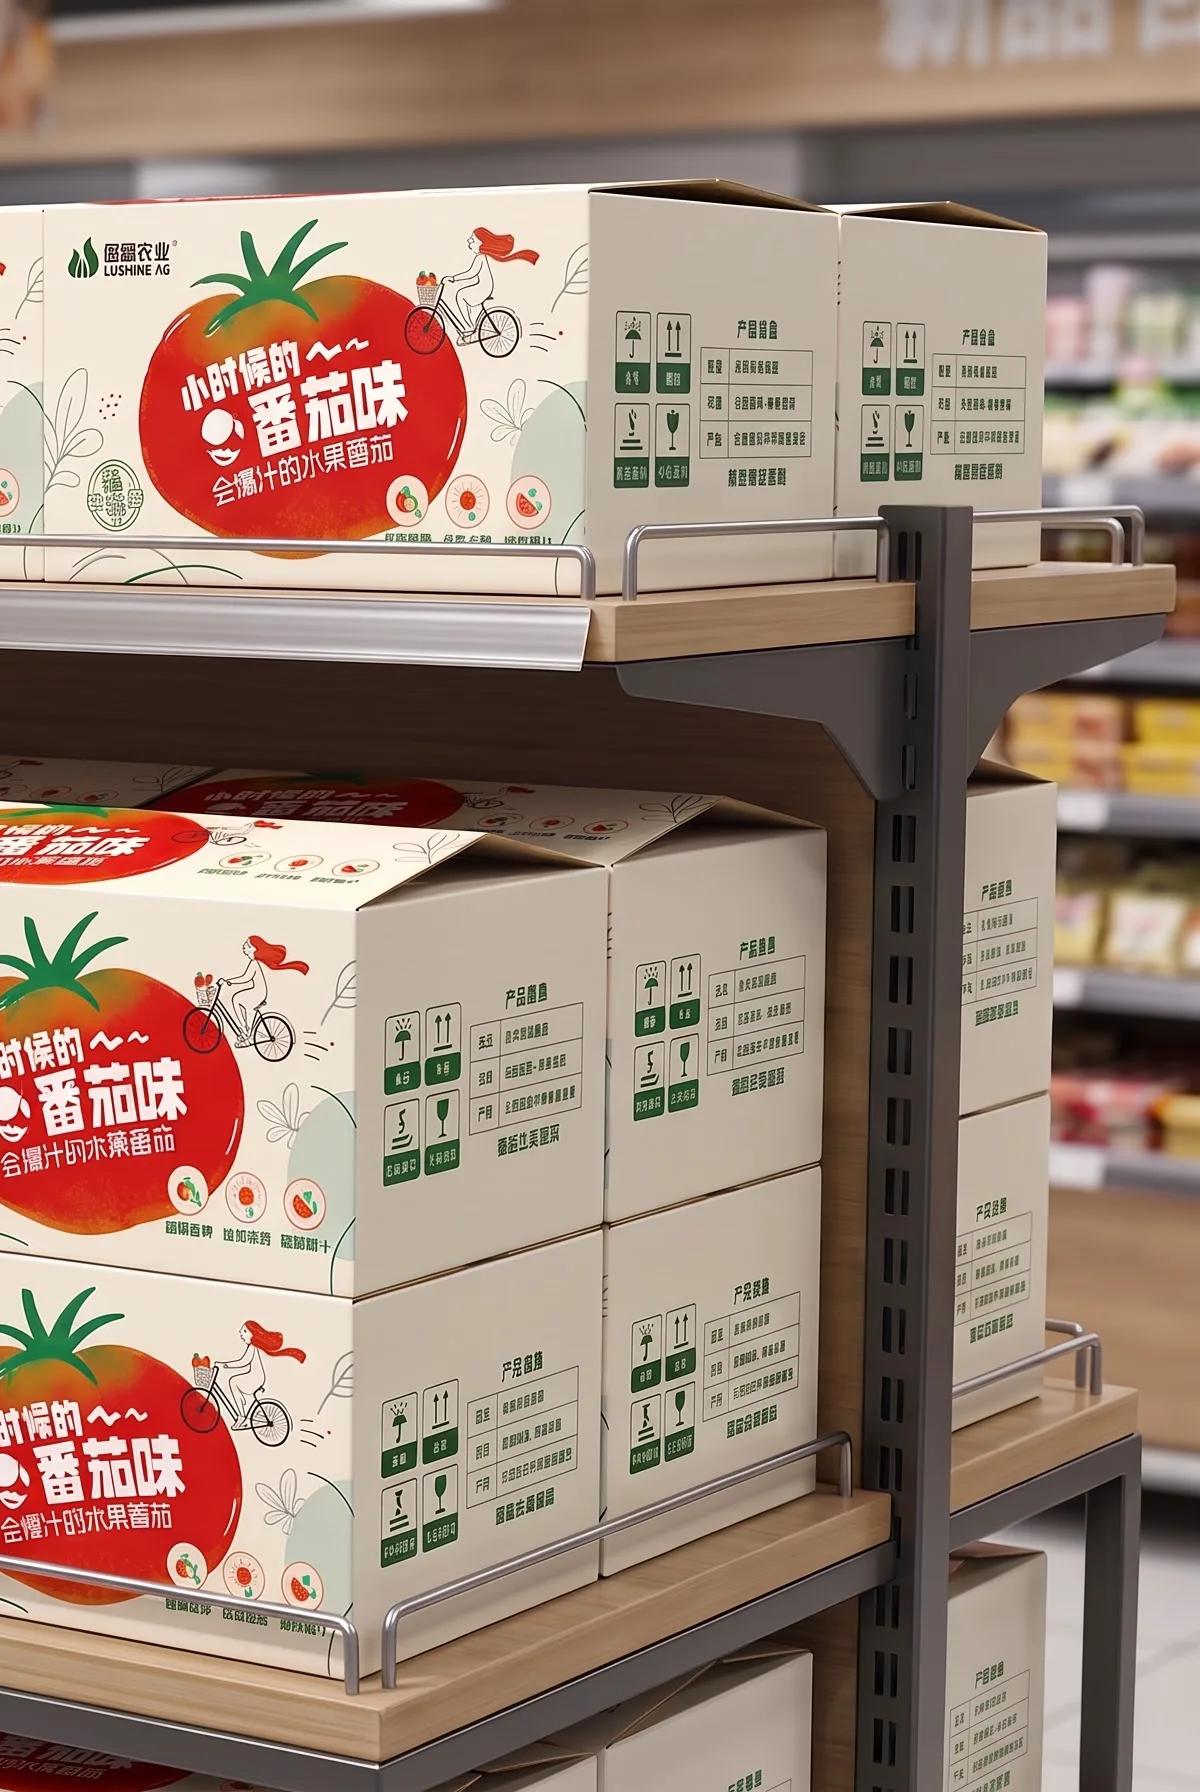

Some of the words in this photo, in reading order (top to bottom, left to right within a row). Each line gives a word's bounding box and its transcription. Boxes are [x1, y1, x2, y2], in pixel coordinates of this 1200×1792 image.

[104, 264, 151, 277] LUSHINE
[180, 339, 300, 412] 小时候的
[252, 359, 409, 459] 番茄味
[34, 1056, 188, 1139] 番茄味
[32, 1434, 187, 1505] 番茄味
